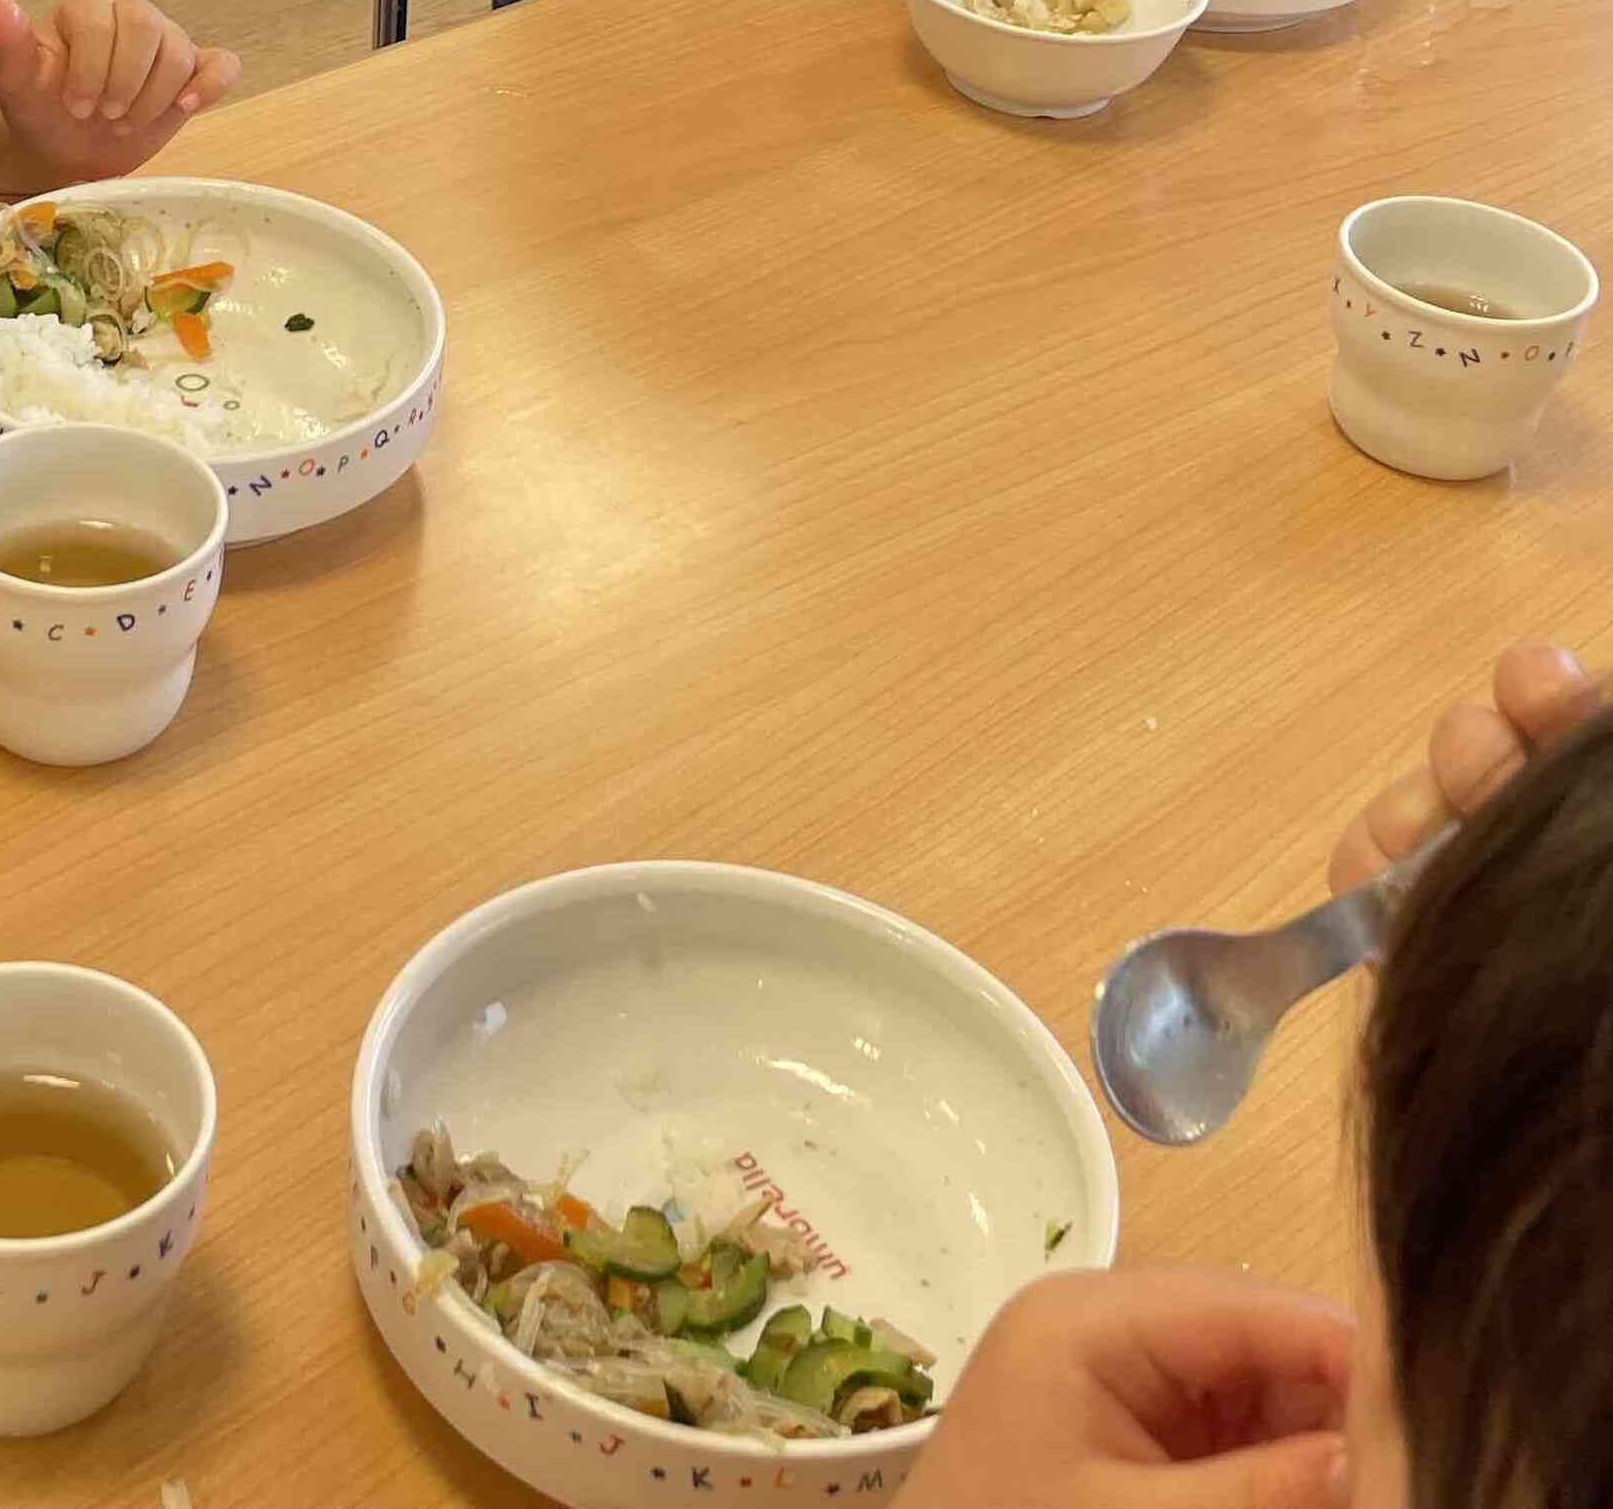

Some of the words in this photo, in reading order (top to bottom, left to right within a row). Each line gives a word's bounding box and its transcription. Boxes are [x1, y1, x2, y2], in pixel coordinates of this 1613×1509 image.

[1408, 330, 1426, 350] Z
[1459, 348, 1482, 368] N
[249, 474, 273, 496] N
[337, 455, 349, 475] P
[374, 428, 391, 449] Q
[47, 624, 65, 642] C
[116, 612, 137, 632] D
[80, 1270, 107, 1297] J
[524, 1392, 546, 1421] I
[599, 1434, 626, 1456] J
[691, 1466, 714, 1491] K
[857, 1468, 884, 1492] M
